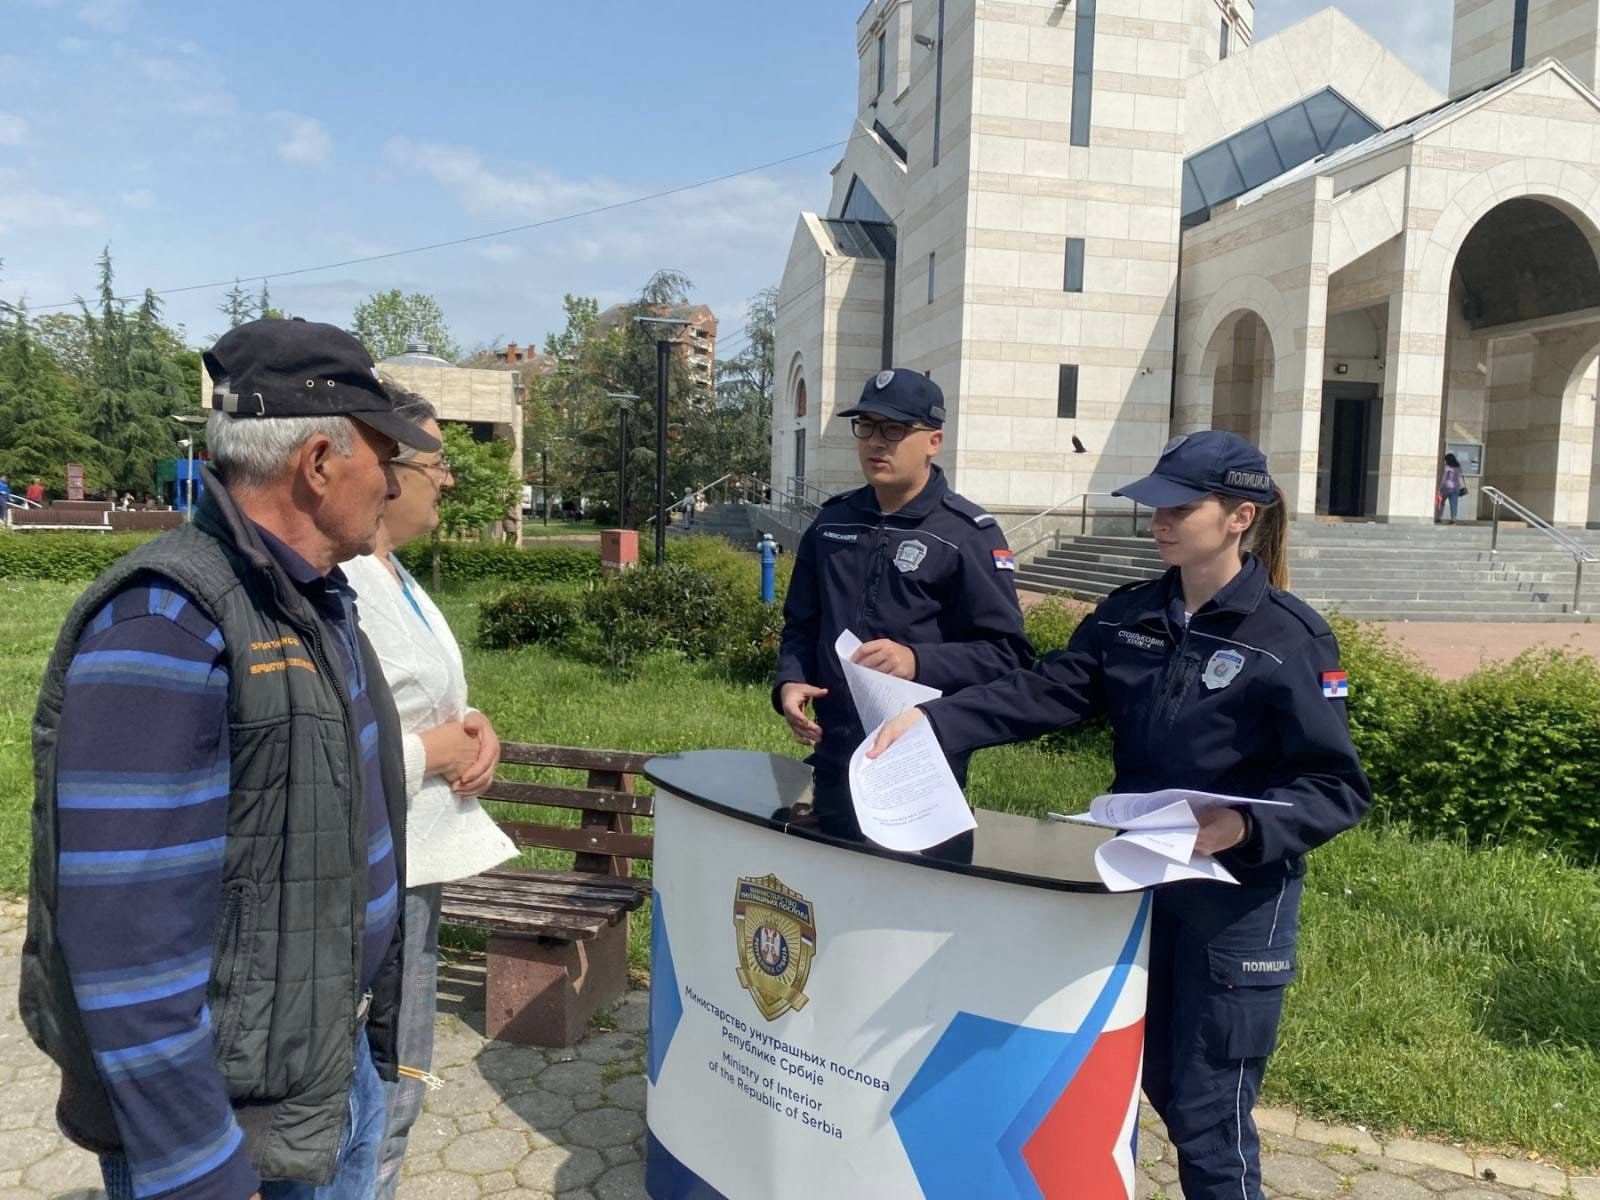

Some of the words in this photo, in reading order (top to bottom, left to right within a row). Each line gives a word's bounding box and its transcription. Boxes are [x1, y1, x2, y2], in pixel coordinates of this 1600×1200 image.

[685, 985, 747, 1032] Министарство
[750, 1027, 827, 1068] унутрашњих
[830, 1061, 890, 1092] послова
[722, 1026, 776, 1065] Републике
[780, 1058, 824, 1085] Србије
[708, 1061, 719, 1072] of
[720, 1066, 735, 1084] the
[737, 1077, 782, 1112] Republic
[785, 1107, 798, 1119] of
[801, 1111, 842, 1139] Serbia
[722, 1051, 759, 1084] Ministry
[762, 1078, 774, 1090] of
[777, 1082, 822, 1111] Interior
